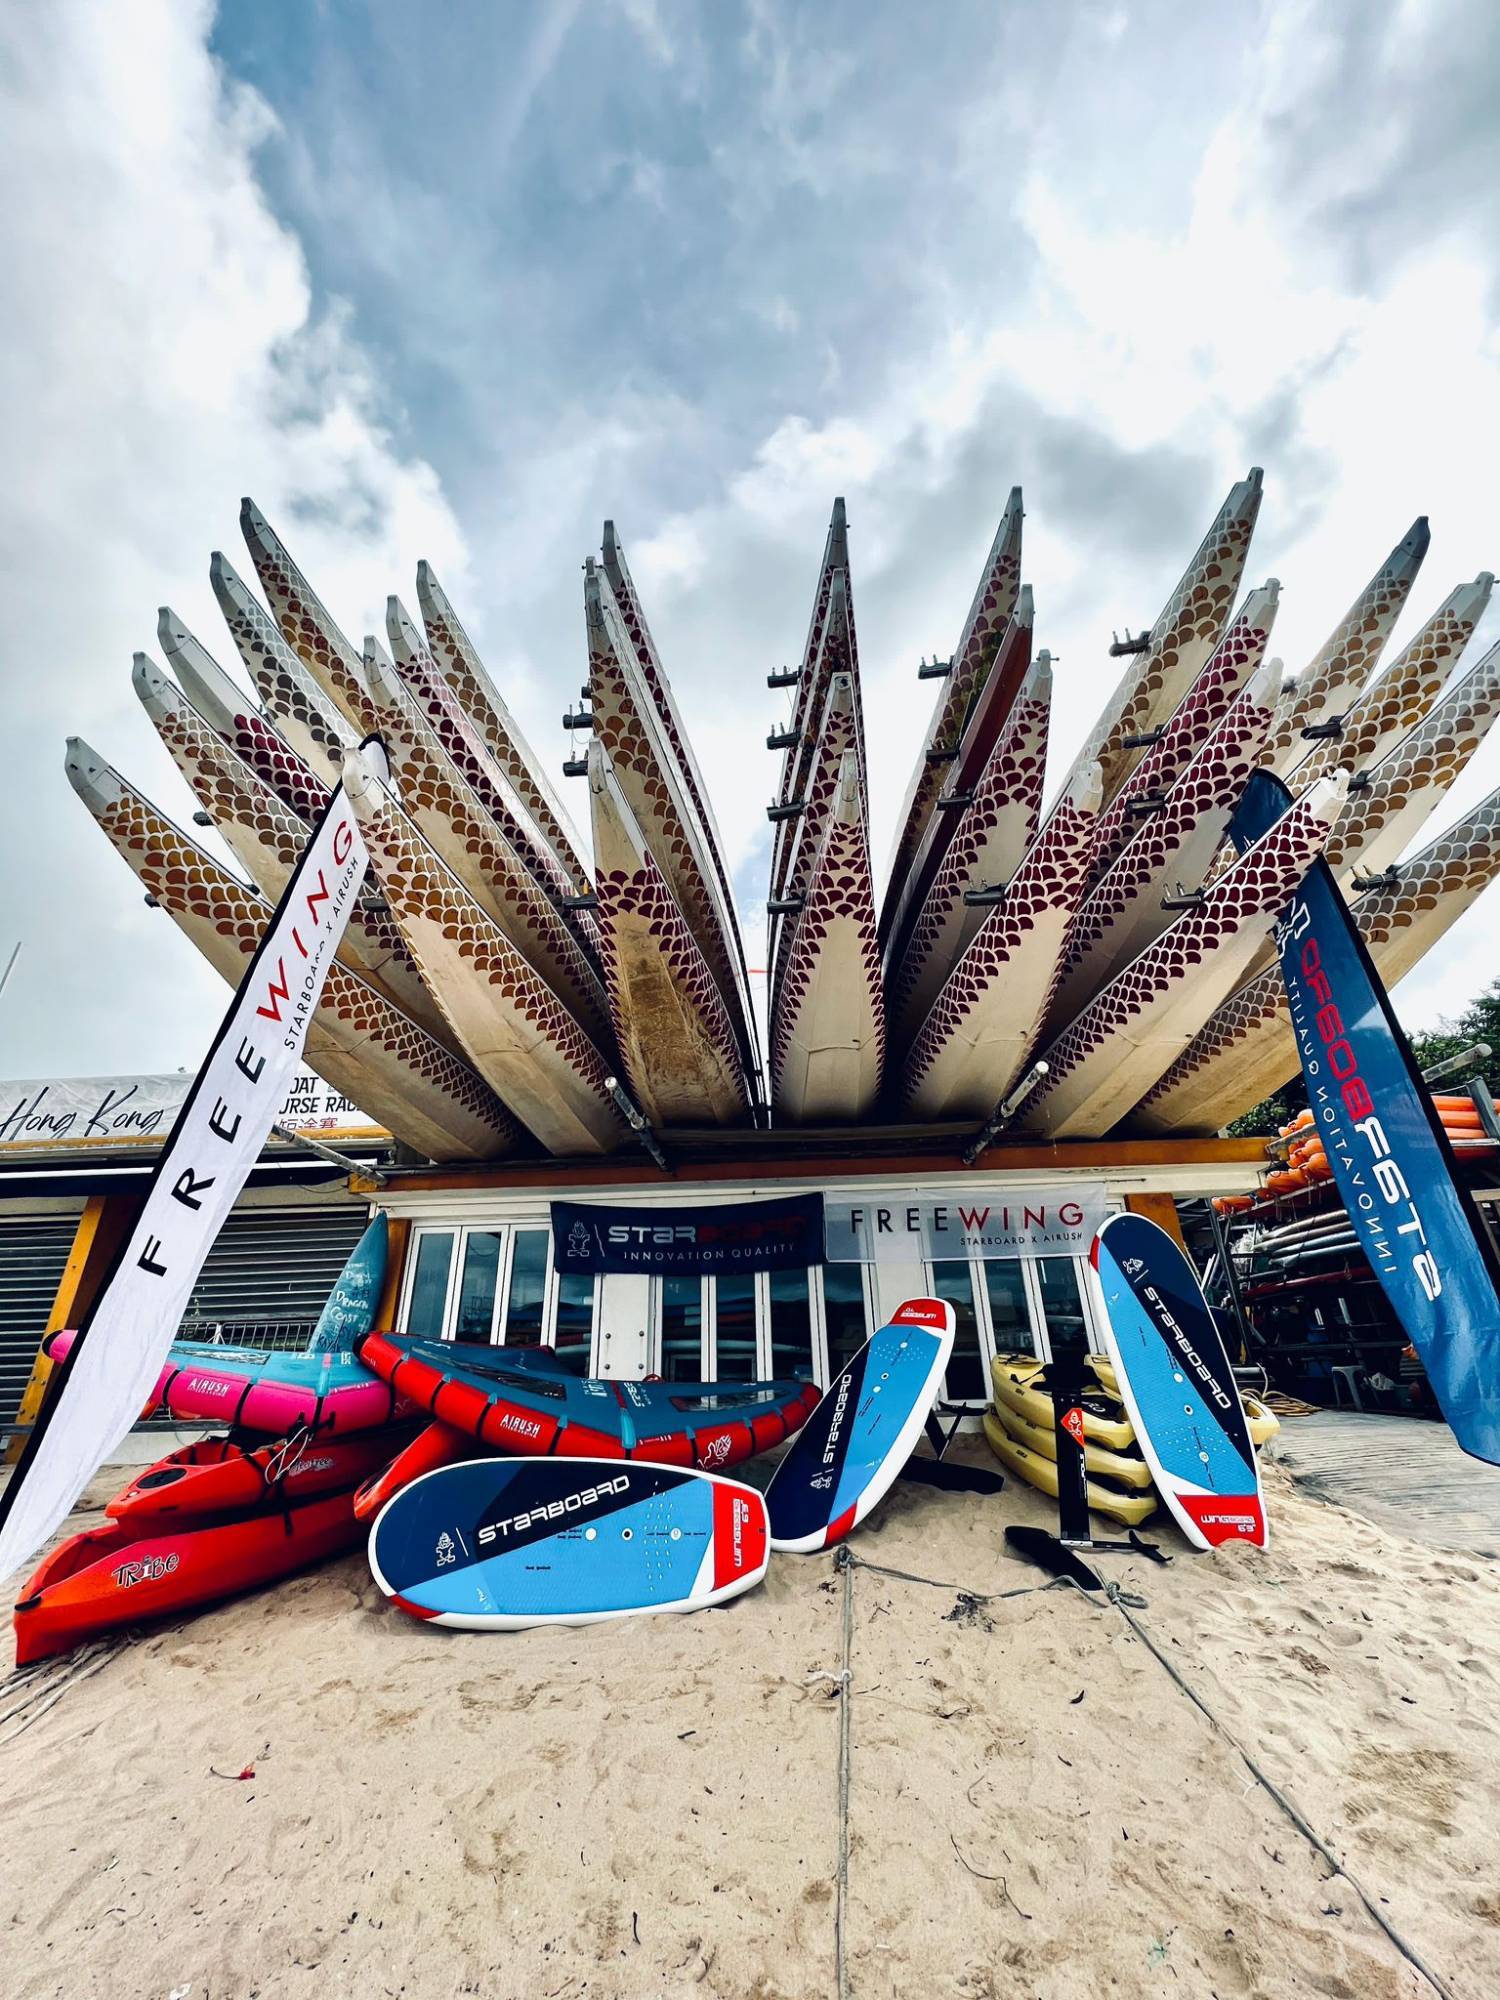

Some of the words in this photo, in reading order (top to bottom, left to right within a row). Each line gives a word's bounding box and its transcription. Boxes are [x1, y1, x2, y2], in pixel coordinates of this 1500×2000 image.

[284, 940, 325, 1050] STARBOARD
[325, 921, 333, 935] X
[333, 858, 359, 918] AIRUSH
[136, 820, 352, 1277] FREEWING
[0, 1086, 77, 1141] Hong
[84, 1085, 164, 1137] Kong
[325, 1096, 359, 1112] RAC
[851, 1203, 1084, 1233] FREEWING
[960, 1236, 1025, 1246] STARBOARD
[1031, 1235, 1038, 1243] X
[1043, 1232, 1082, 1242] AIRUSH
[624, 1250, 724, 1261] INNOVATION
[732, 1244, 794, 1258] QUALITY
[1144, 1287, 1231, 1409] STARBOARD
[189, 1378, 230, 1393] AIRUSH
[501, 1414, 541, 1433] AIRUSH
[823, 1374, 852, 1463] STARBOARD
[479, 1475, 630, 1544] STARBOARD
